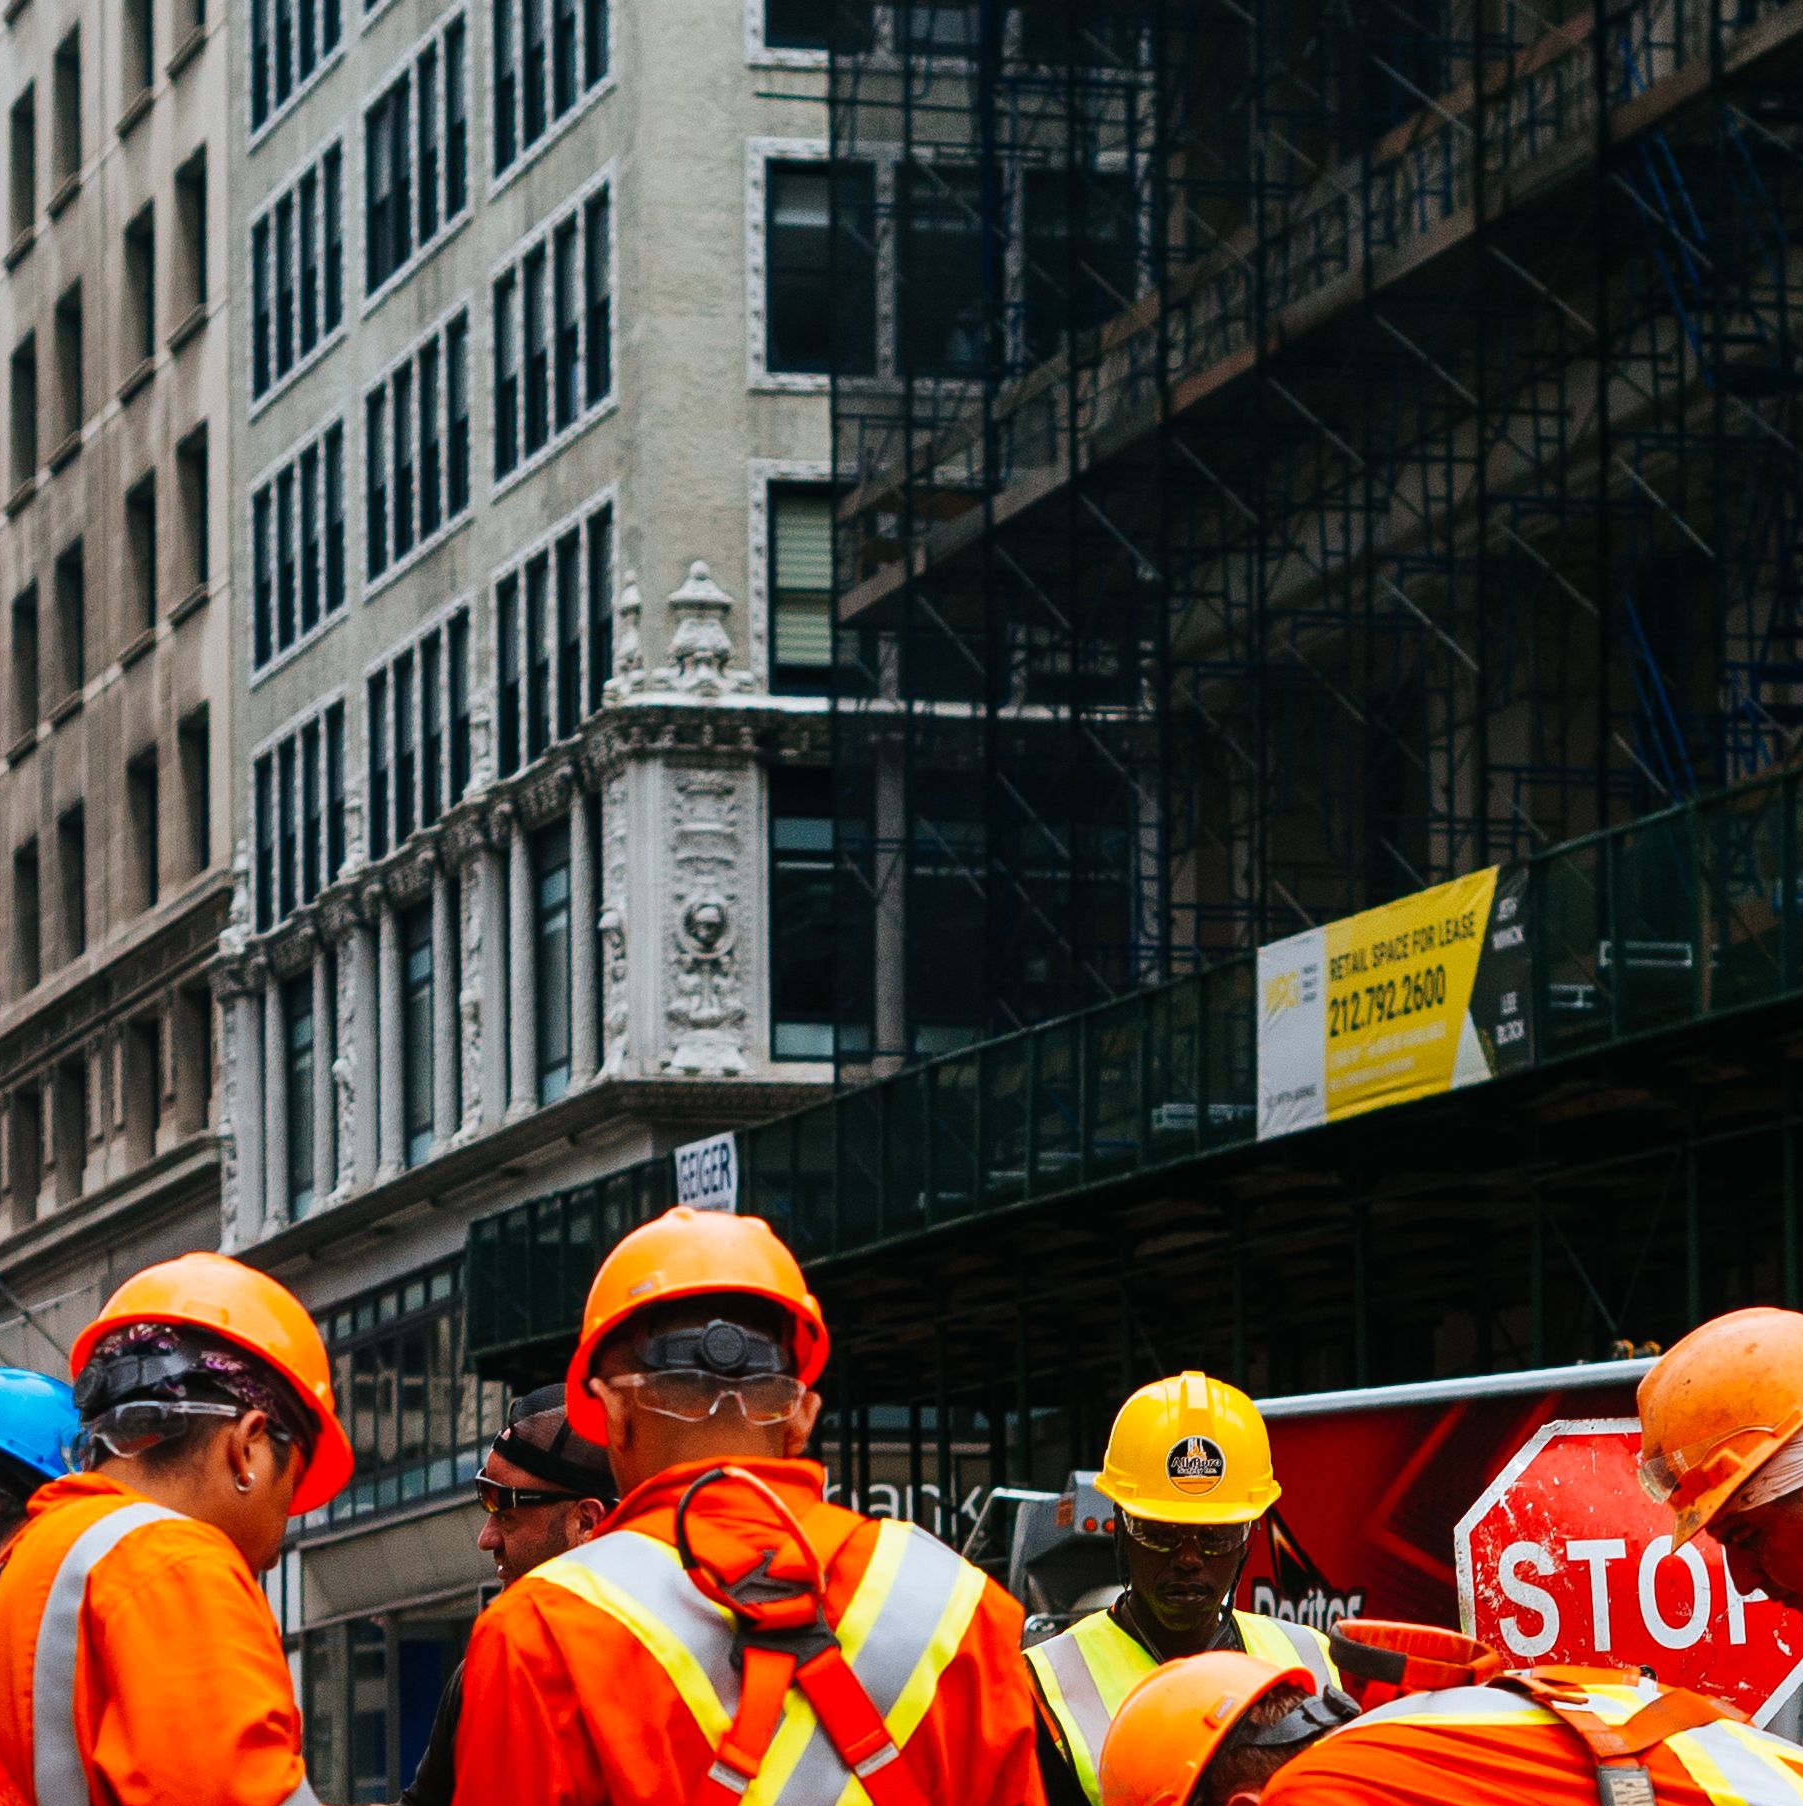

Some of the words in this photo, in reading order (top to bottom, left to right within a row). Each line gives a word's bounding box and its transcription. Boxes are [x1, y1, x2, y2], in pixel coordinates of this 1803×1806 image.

[1439, 911, 1475, 946] LEASE
[1330, 964, 1446, 1037] 212.792.2600
[681, 1142, 731, 1202] GEIGER
